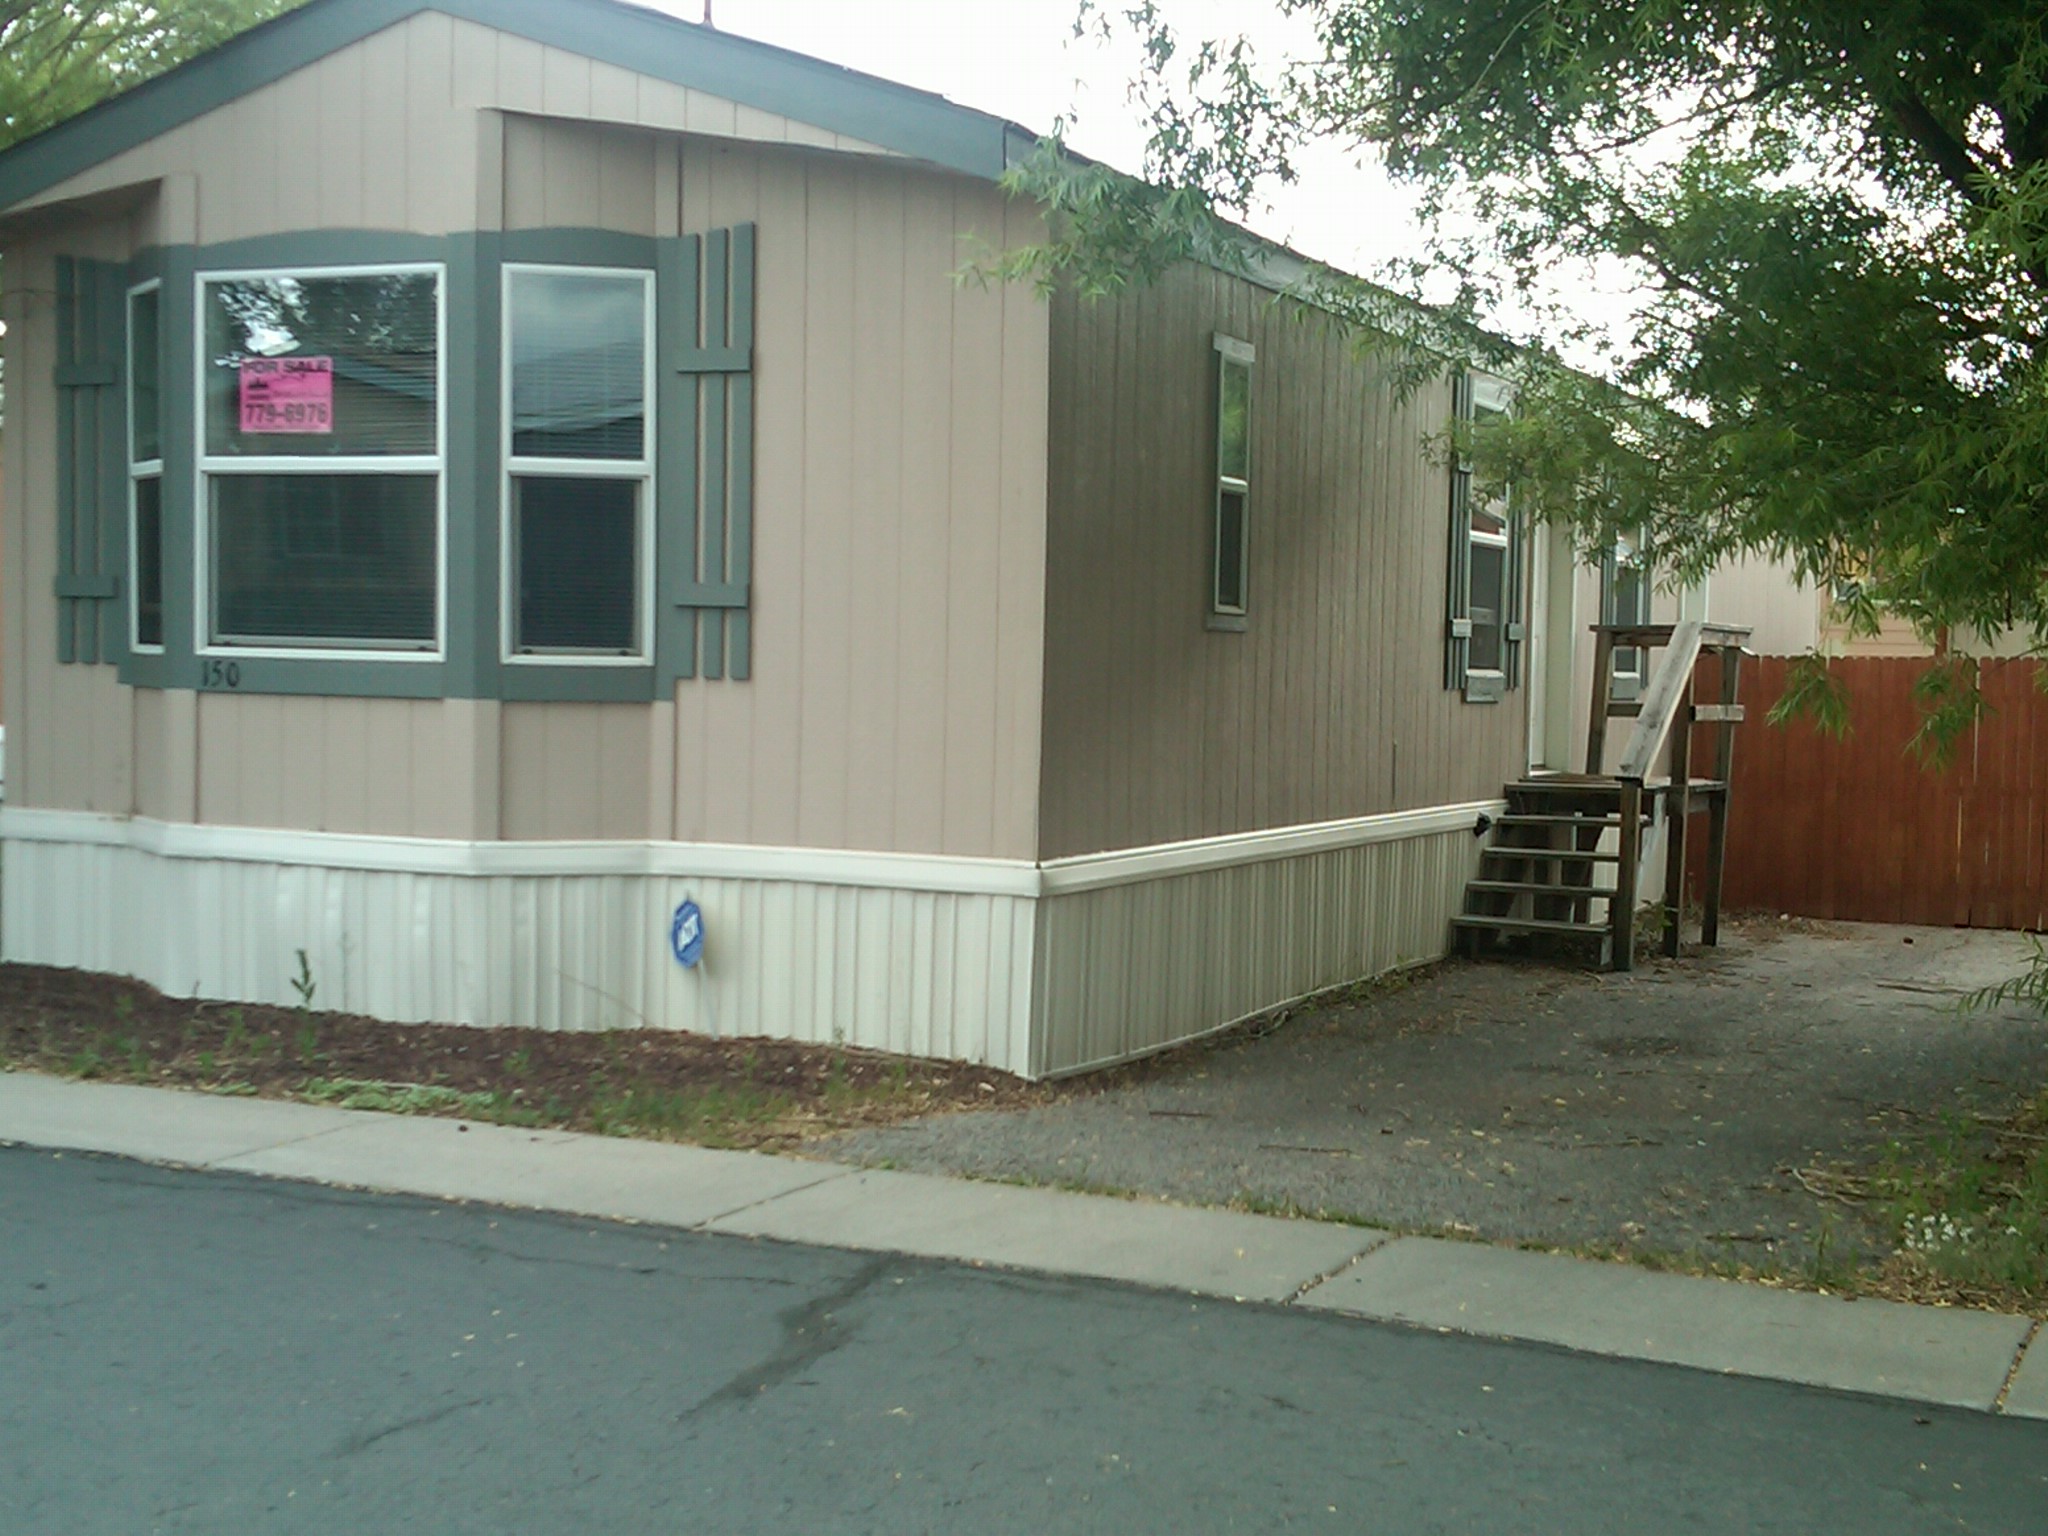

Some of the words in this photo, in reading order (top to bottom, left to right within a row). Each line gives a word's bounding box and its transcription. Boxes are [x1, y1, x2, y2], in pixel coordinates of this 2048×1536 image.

[243, 360, 278, 374] FOR
[283, 360, 328, 373] SALE
[201, 660, 241, 688] 150
